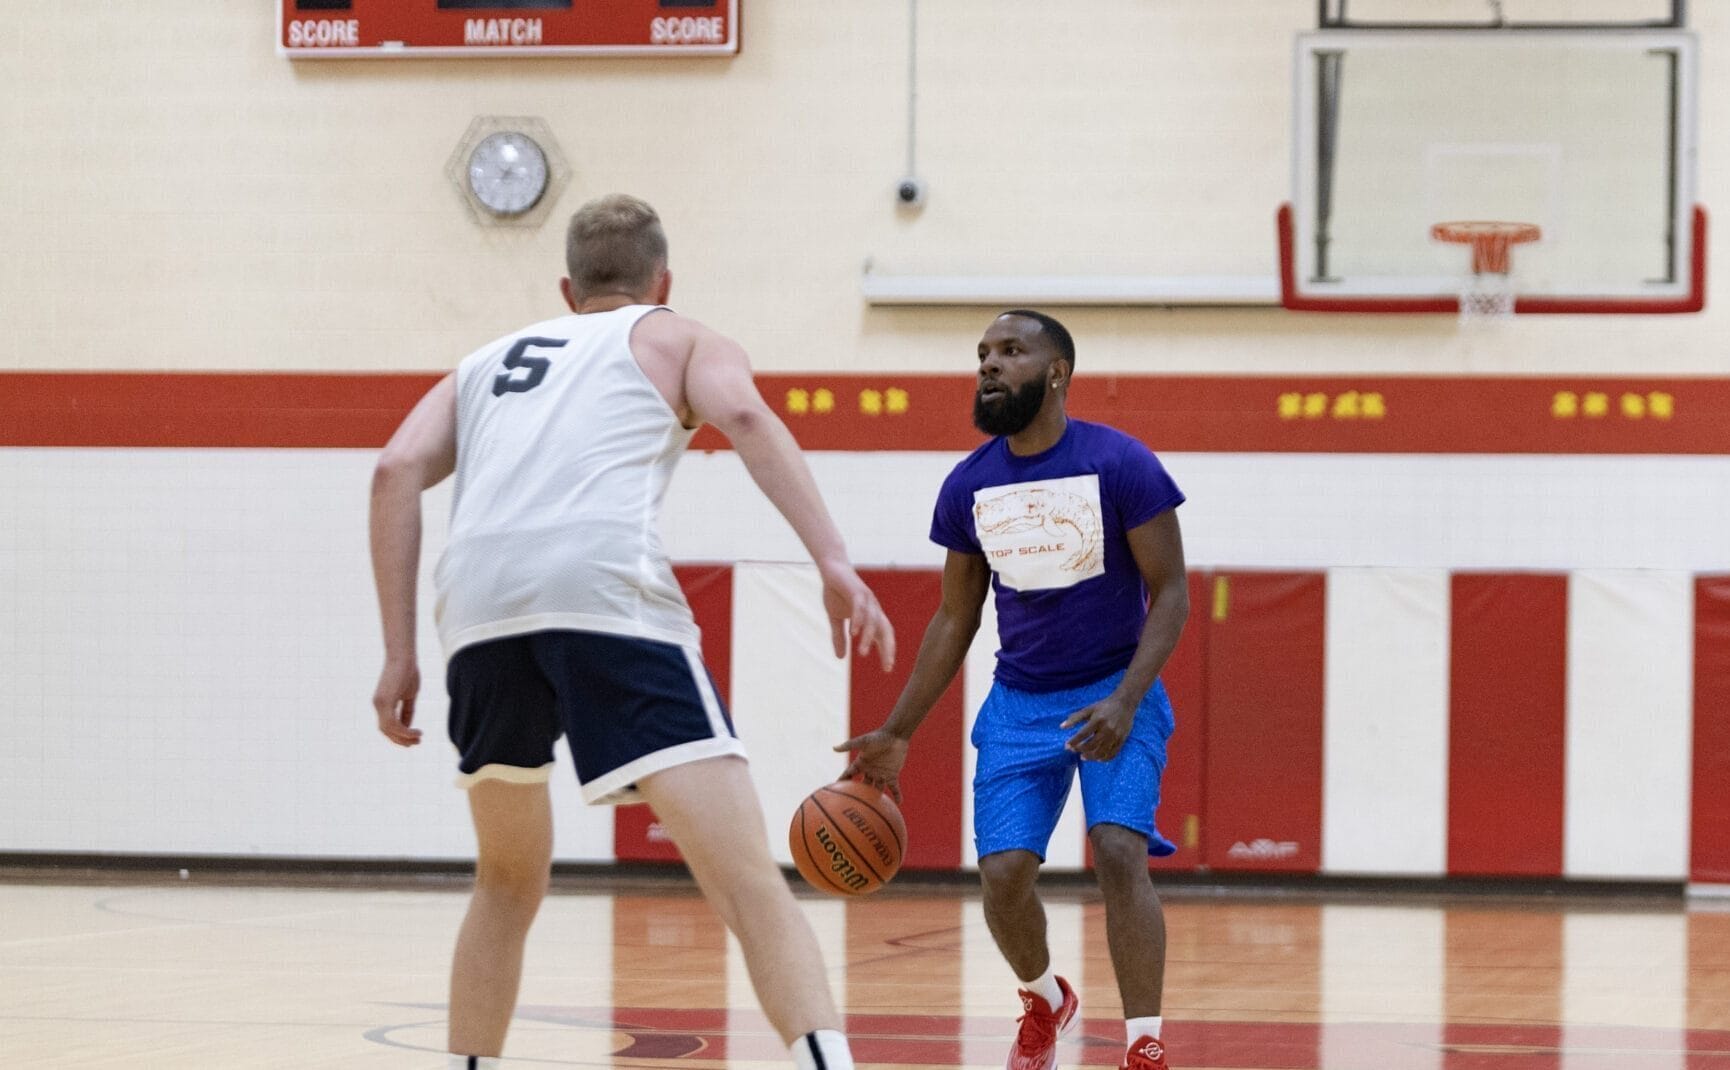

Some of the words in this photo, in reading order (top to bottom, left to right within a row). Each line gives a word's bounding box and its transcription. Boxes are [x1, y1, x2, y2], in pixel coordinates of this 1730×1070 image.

[288, 19, 359, 45] SCORE
[464, 18, 543, 44] MATCH
[650, 17, 724, 43] SCORE
[491, 336, 570, 398] 5
[990, 549, 1013, 559] TOP
[1018, 542, 1065, 556] SCALE
[843, 807, 893, 867] EVOLUTION
[815, 824, 870, 890] Wilson
